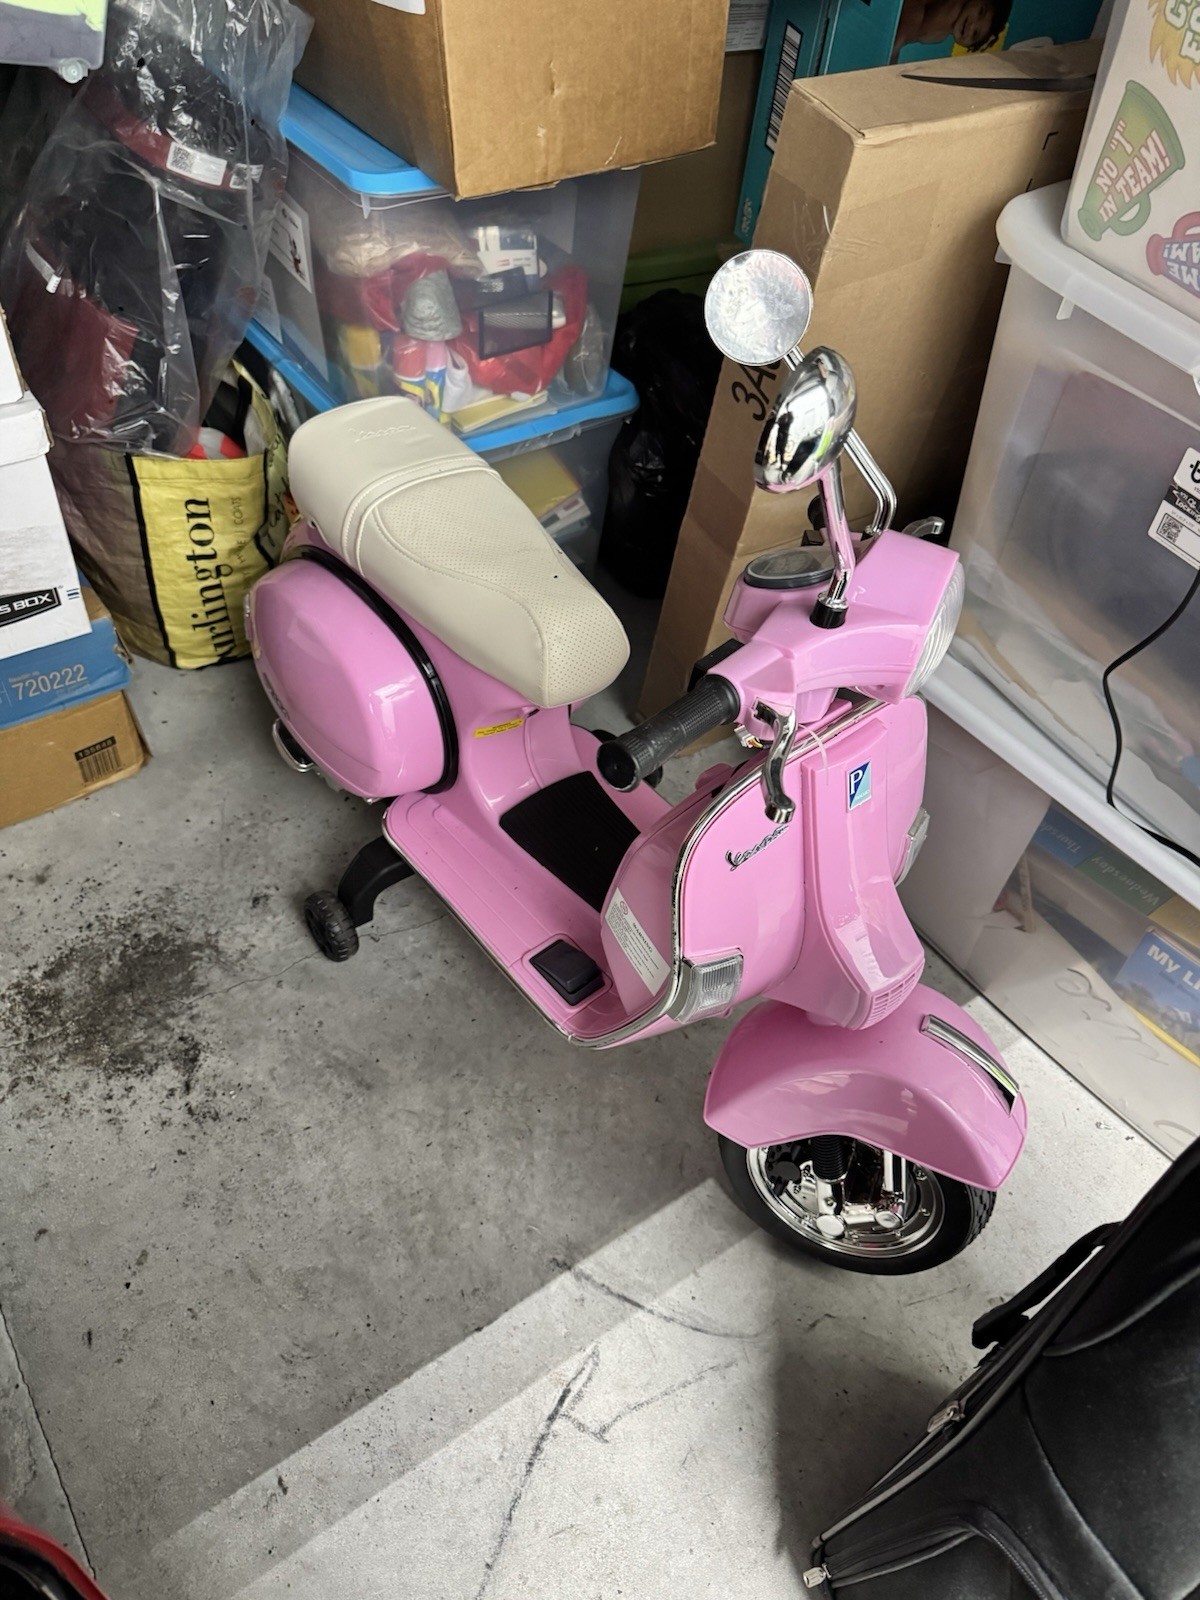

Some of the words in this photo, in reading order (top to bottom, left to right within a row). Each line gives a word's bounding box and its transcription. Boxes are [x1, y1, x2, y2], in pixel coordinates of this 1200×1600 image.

[1095, 157, 1119, 194] NO
[1098, 194, 1118, 222] IN
[1114, 129, 1172, 203] TEAM!
[12, 592, 53, 612] BOX
[11, 663, 89, 702] 720222
[1091, 855, 1161, 906] Wednesday
[1146, 944, 1182, 974] My
